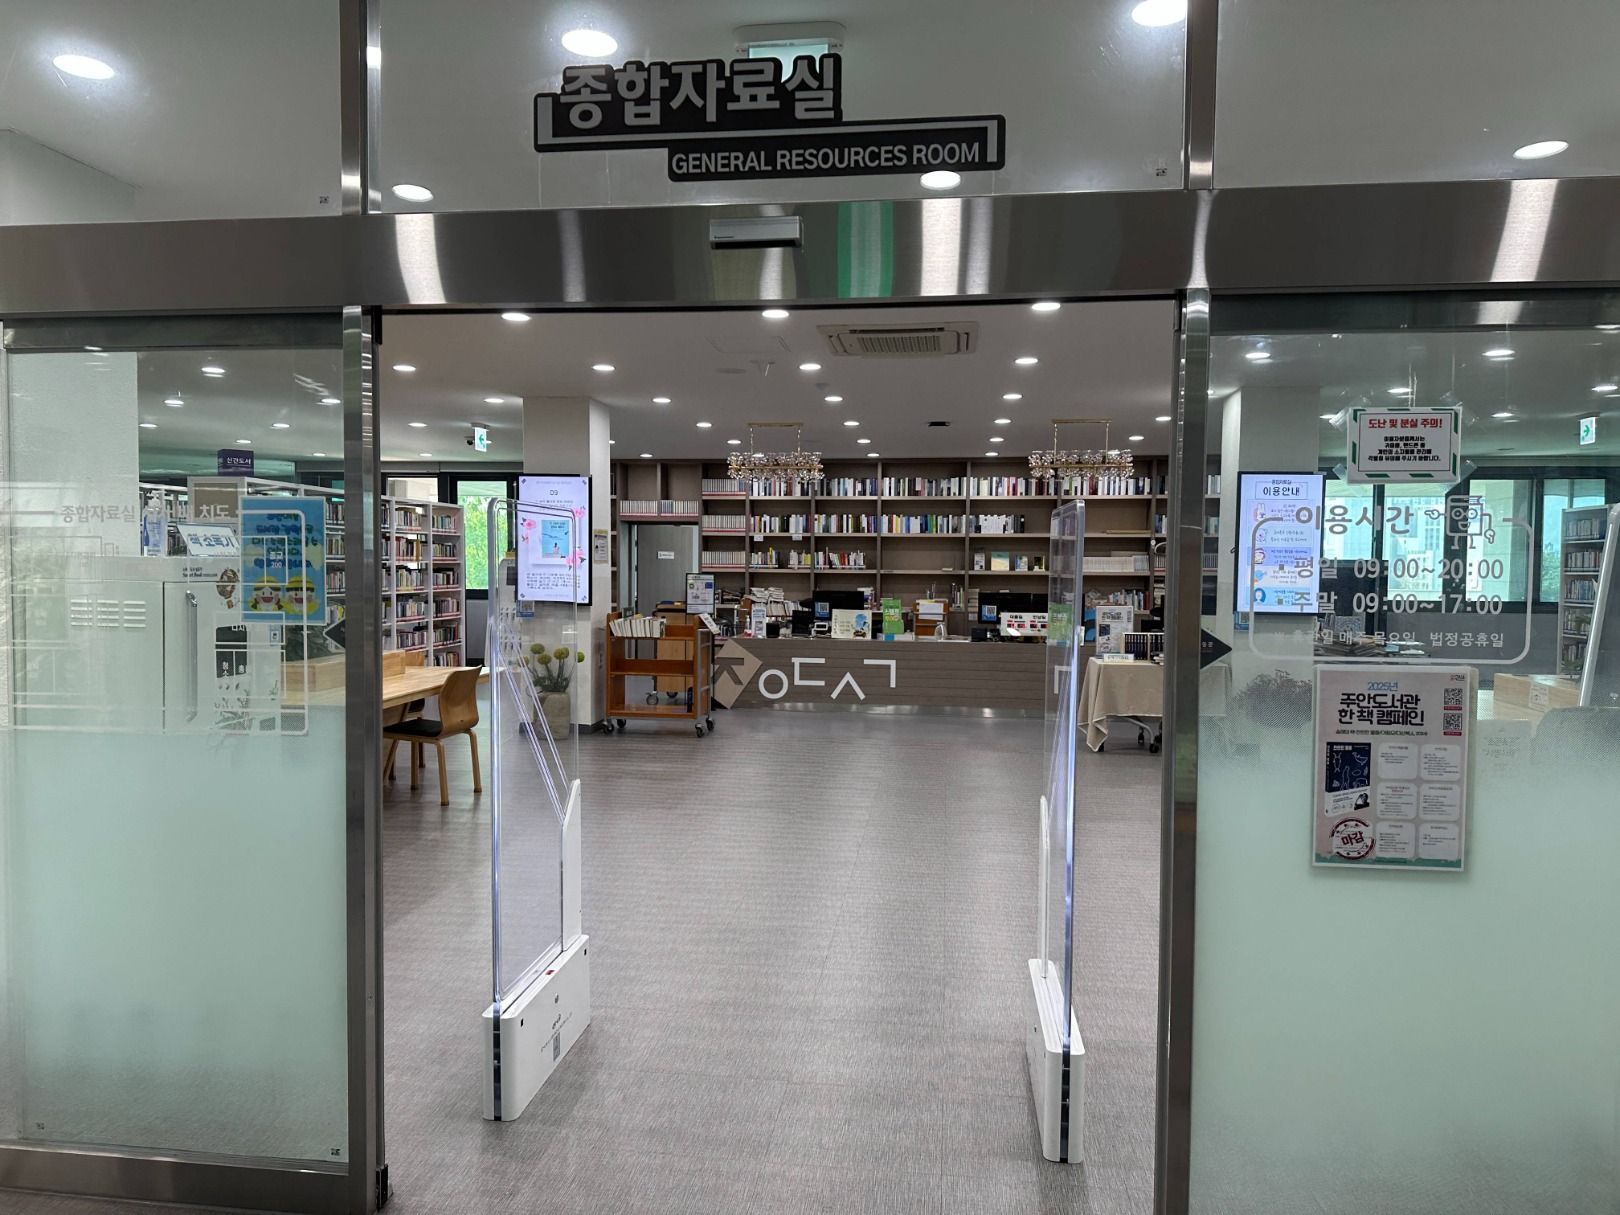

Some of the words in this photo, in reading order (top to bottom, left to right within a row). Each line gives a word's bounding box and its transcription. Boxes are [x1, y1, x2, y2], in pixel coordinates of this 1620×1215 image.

[560, 57, 835, 129] 종합자료실
[672, 149, 772, 174] GENERAL
[776, 145, 907, 170] RESOURCES
[912, 142, 979, 166] ROOM
[1368, 418, 1387, 428] 도난
[1389, 418, 1398, 428] 및
[1400, 418, 1418, 428] 분실
[1421, 418, 1443, 428] 주의!
[1263, 486, 1299, 497] 이용안내
[60, 504, 136, 524] 종합자료실
[1295, 505, 1414, 535] 이용시간
[1294, 555, 1338, 579] 평일
[1354, 558, 1504, 579] 09:00~20:00
[1291, 591, 1338, 614] 주말
[1352, 594, 1503, 614] 09:00~17:00
[1430, 632, 1504, 648] 법정공휴일
[1340, 692, 1421, 710] 주안도서관
[1338, 708, 1355, 725] 한
[1356, 708, 1373, 725] 책
[1376, 709, 1425, 726] 캠페인
[1341, 830, 1365, 846] 마감
